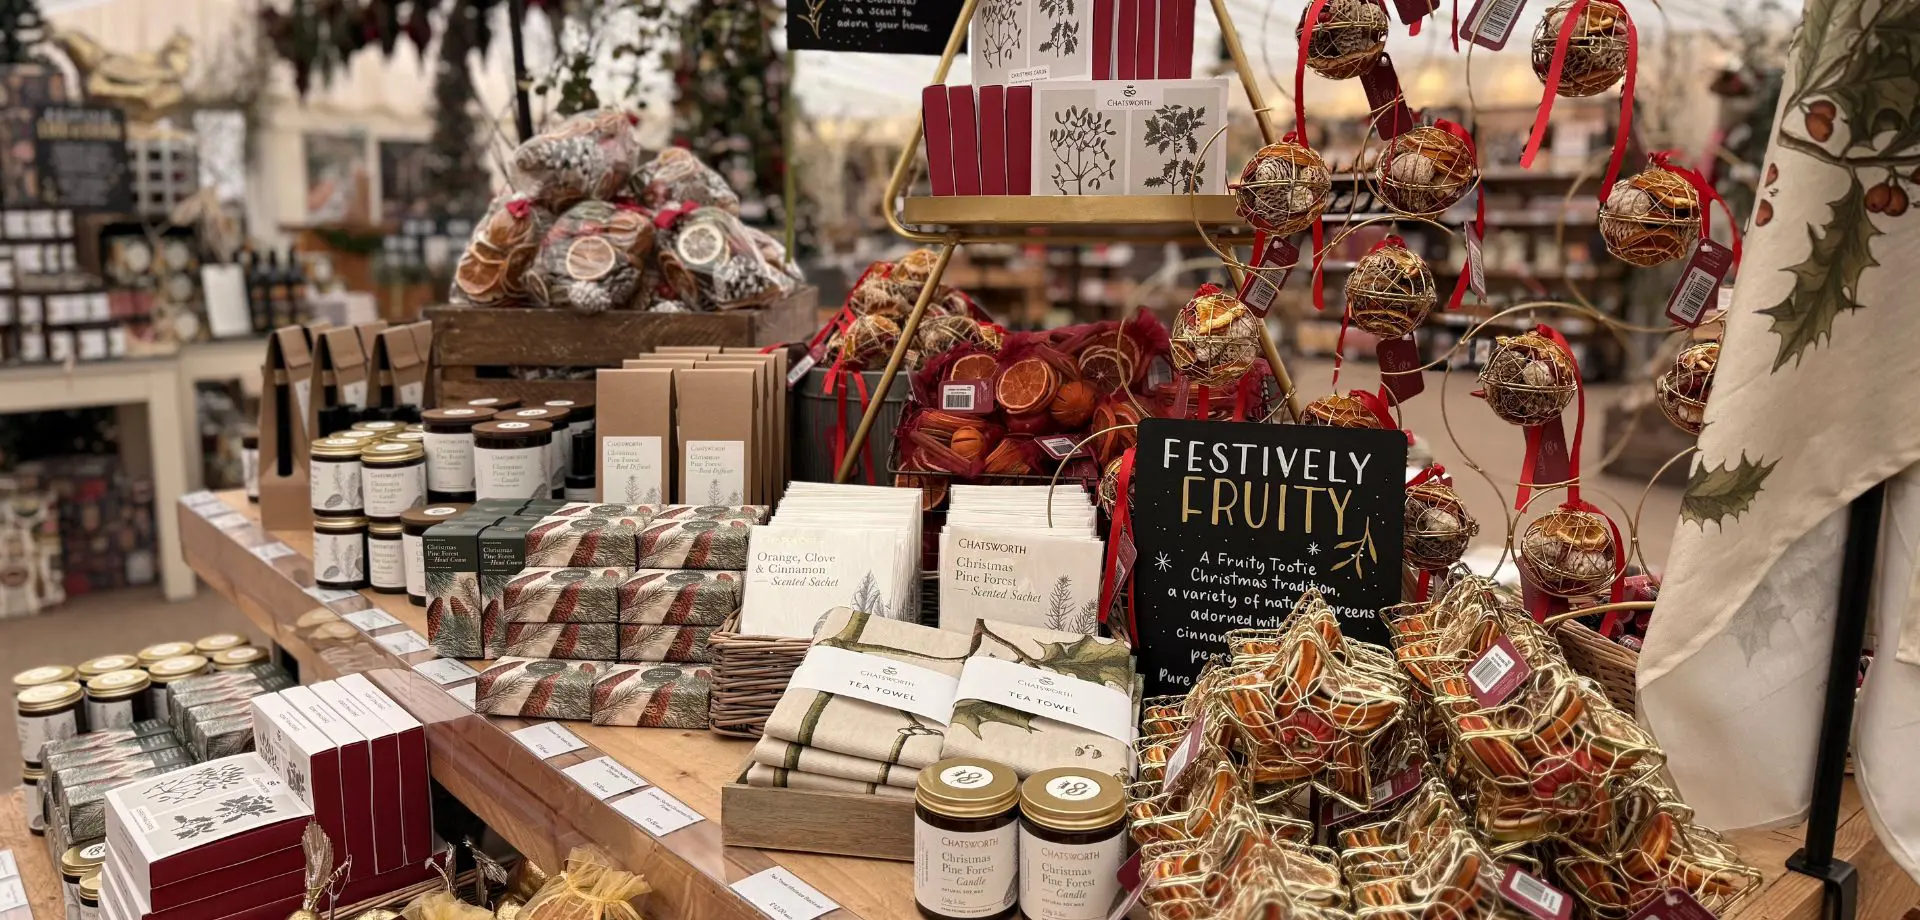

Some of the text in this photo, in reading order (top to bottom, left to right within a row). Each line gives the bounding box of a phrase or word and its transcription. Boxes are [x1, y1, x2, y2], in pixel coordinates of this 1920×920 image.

[842, 5, 912, 17] in a scent to
[837, 19, 869, 28] adorn
[875, 22, 899, 32] your
[1163, 438, 1372, 485] FESTIVELY
[1181, 476, 1352, 536] FRUITY
[958, 538, 1027, 555] CHATSWORTH
[757, 551, 836, 564] Orange, Clove
[956, 556, 1014, 573] Christmas
[1200, 551, 1317, 576] A Fruity Tootie
[755, 563, 826, 574] & Cinnamon
[771, 576, 839, 588] Scented Sachet
[955, 569, 1017, 587] Pine Forest
[1191, 567, 1268, 589] Christmas
[971, 586, 1042, 603] Scented Sachet
[1167, 587, 1177, 598] a
[1183, 590, 1237, 609] variety
[1244, 595, 1260, 609] of
[1190, 609, 1284, 628] adorned with
[860, 670, 915, 687] CHATSWORTH
[1159, 667, 1191, 687] Pure
[849, 680, 916, 702] TEA TOWEL
[1017, 679, 1073, 698] CHATSWORTH
[1008, 690, 1079, 714] TEA TOWEL
[941, 836, 999, 849] CHATSWORTH
[942, 852, 991, 864] Christmas
[1041, 848, 1100, 860] CHATSWORTH
[942, 862, 995, 875] Pine Forest
[1041, 862, 1092, 876] Christmas
[956, 876, 987, 887] Candle
[1042, 873, 1095, 888] Pine Forest
[1056, 888, 1087, 899] Candle
